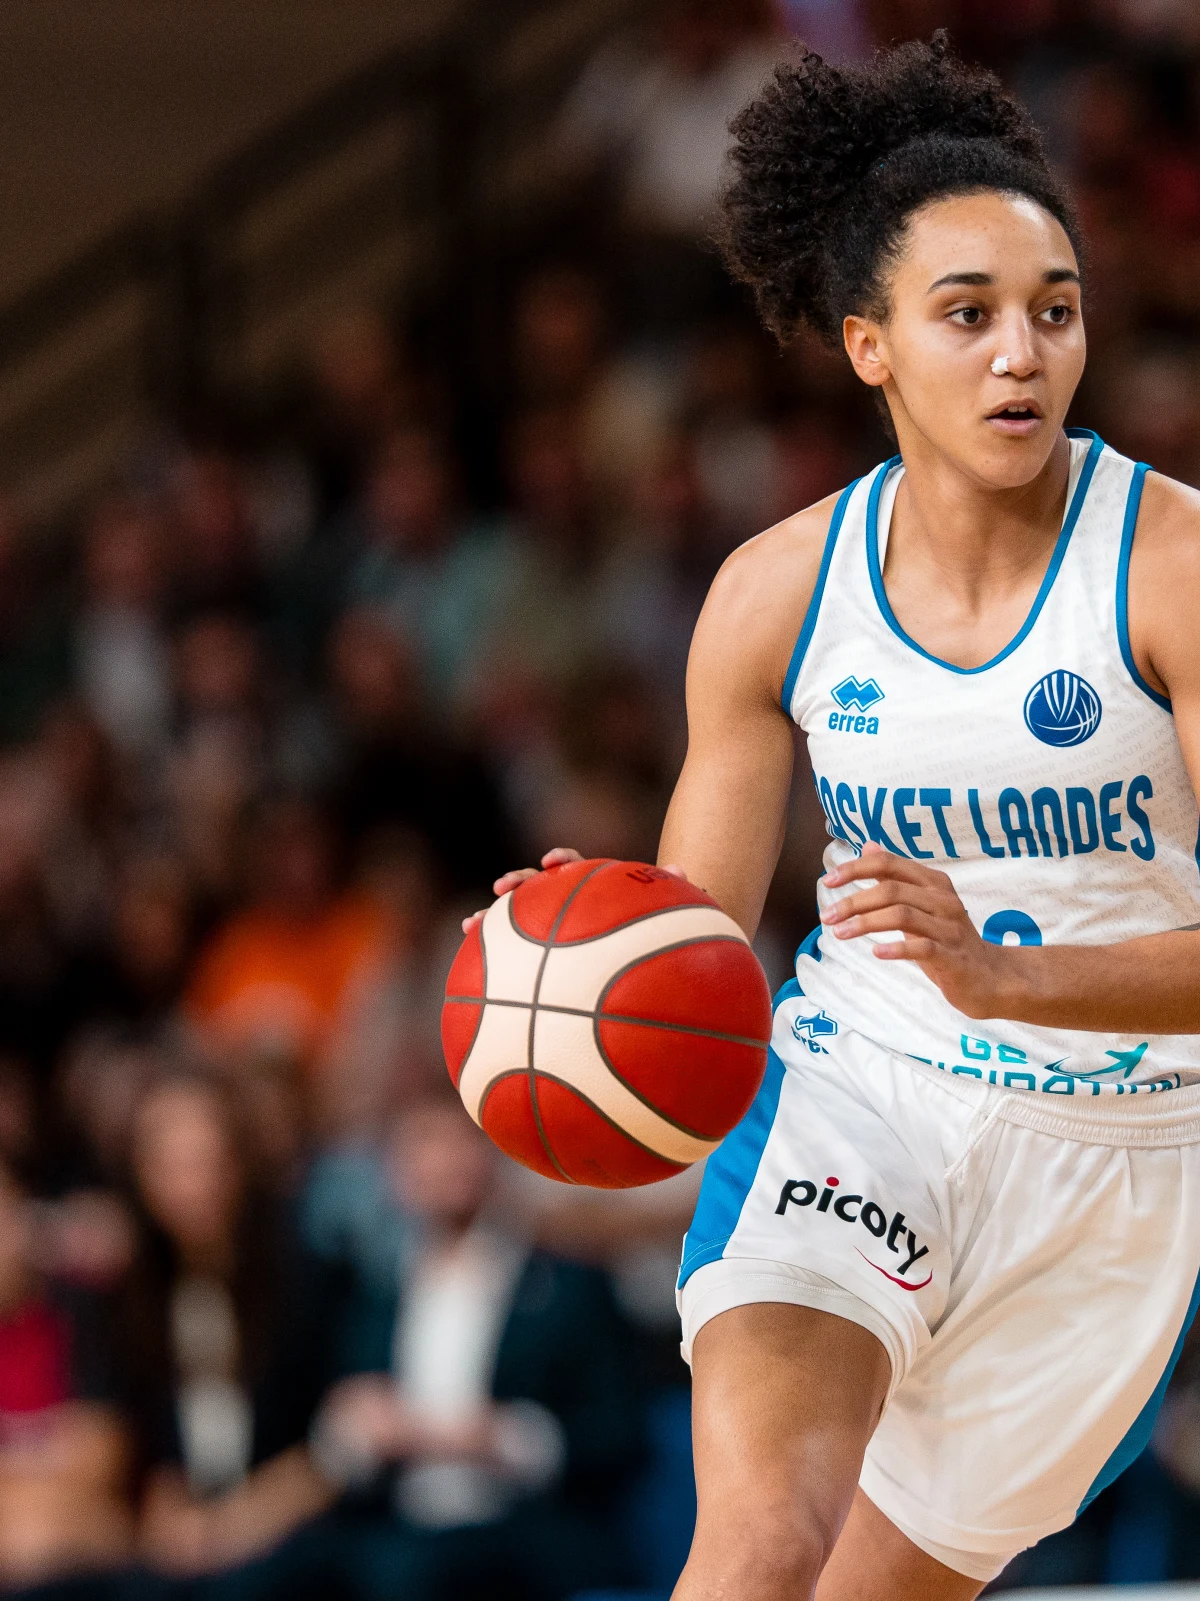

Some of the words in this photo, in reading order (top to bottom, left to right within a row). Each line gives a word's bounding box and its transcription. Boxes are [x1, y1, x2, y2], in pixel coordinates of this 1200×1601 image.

[828, 712, 879, 735] errea
[812, 768, 960, 859] ASKET
[968, 775, 1155, 861] LANDES
[775, 1177, 929, 1275] picoty
